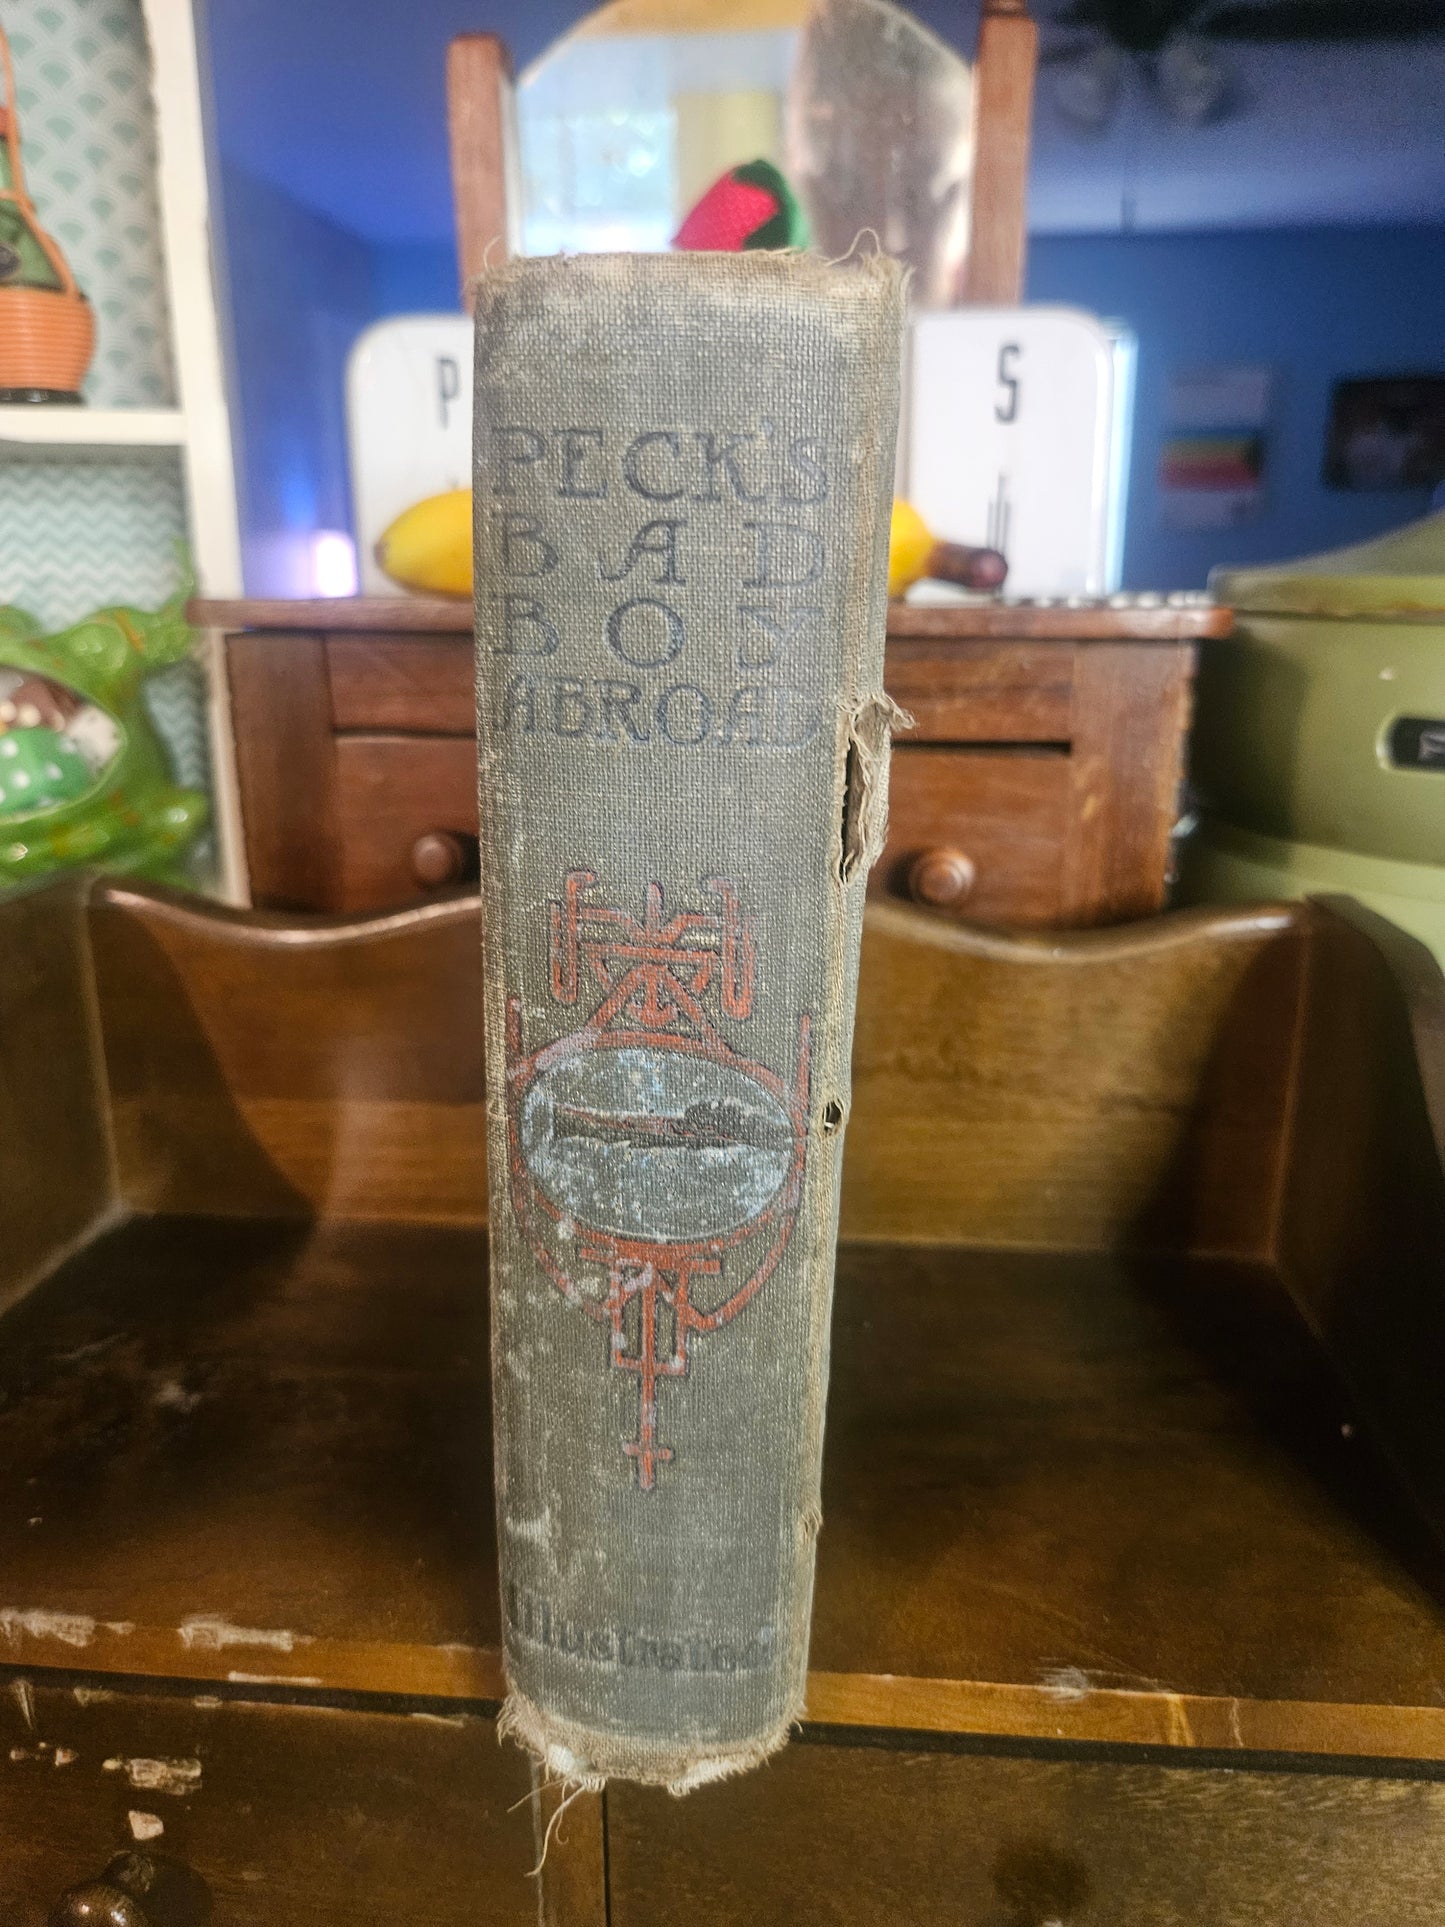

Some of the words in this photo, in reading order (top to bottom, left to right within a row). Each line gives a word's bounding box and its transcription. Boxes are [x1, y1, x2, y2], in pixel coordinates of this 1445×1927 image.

[491, 511, 826, 589] BAD
[491, 594, 824, 670] BOY
[495, 673, 824, 749] ABROAD
